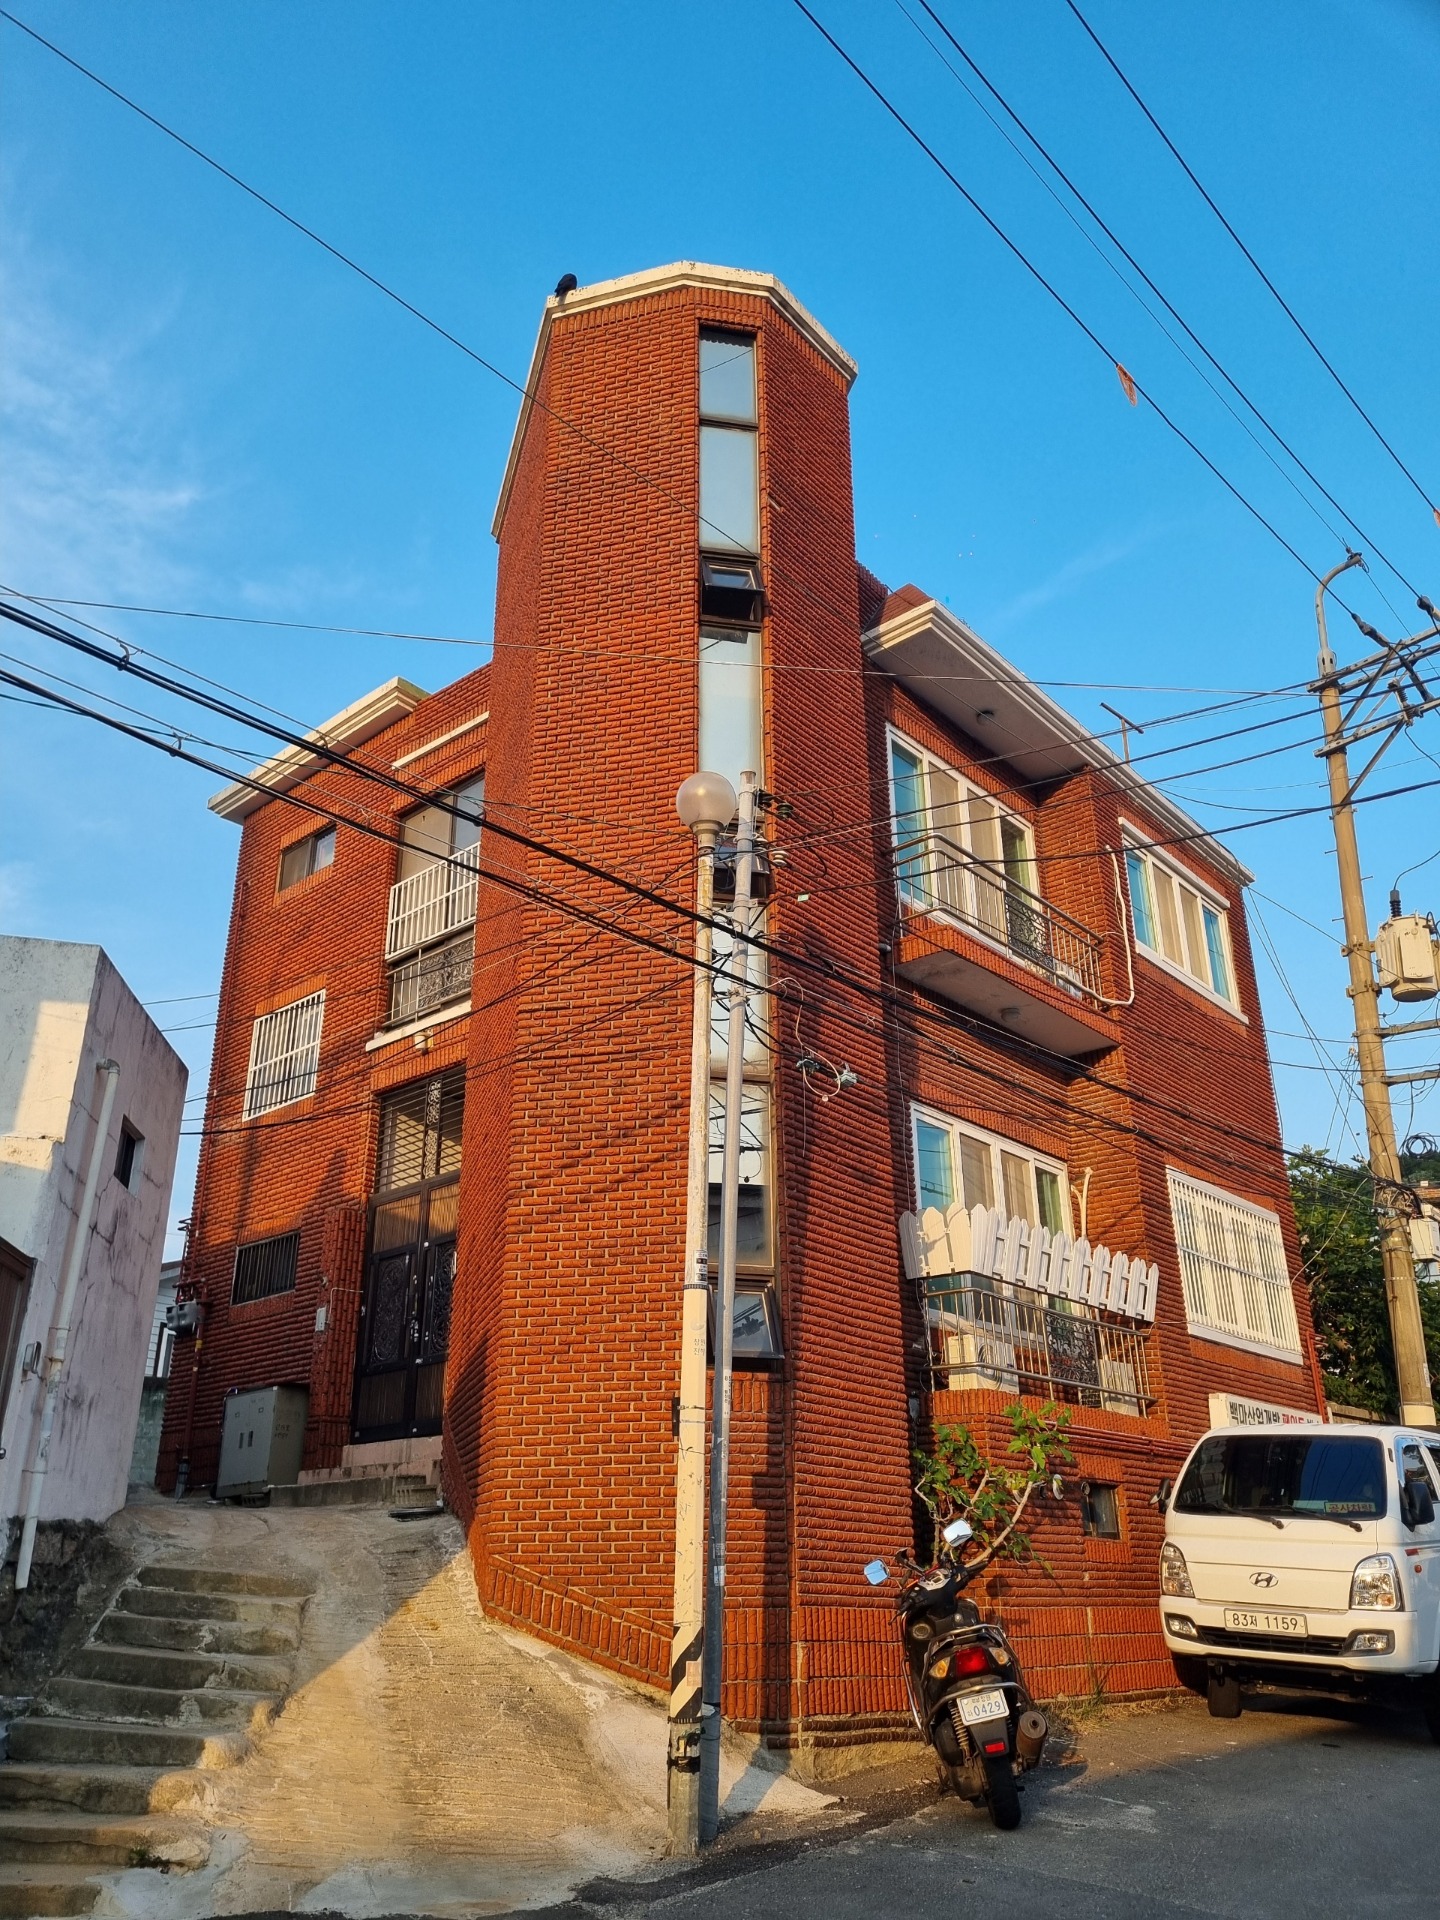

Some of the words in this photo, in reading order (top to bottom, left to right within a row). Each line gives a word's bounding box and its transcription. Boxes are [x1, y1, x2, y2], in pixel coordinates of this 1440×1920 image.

[1232, 1612, 1258, 1628] 83저
[1264, 1615, 1298, 1631] 1159
[973, 1700, 1001, 1717] 0429
